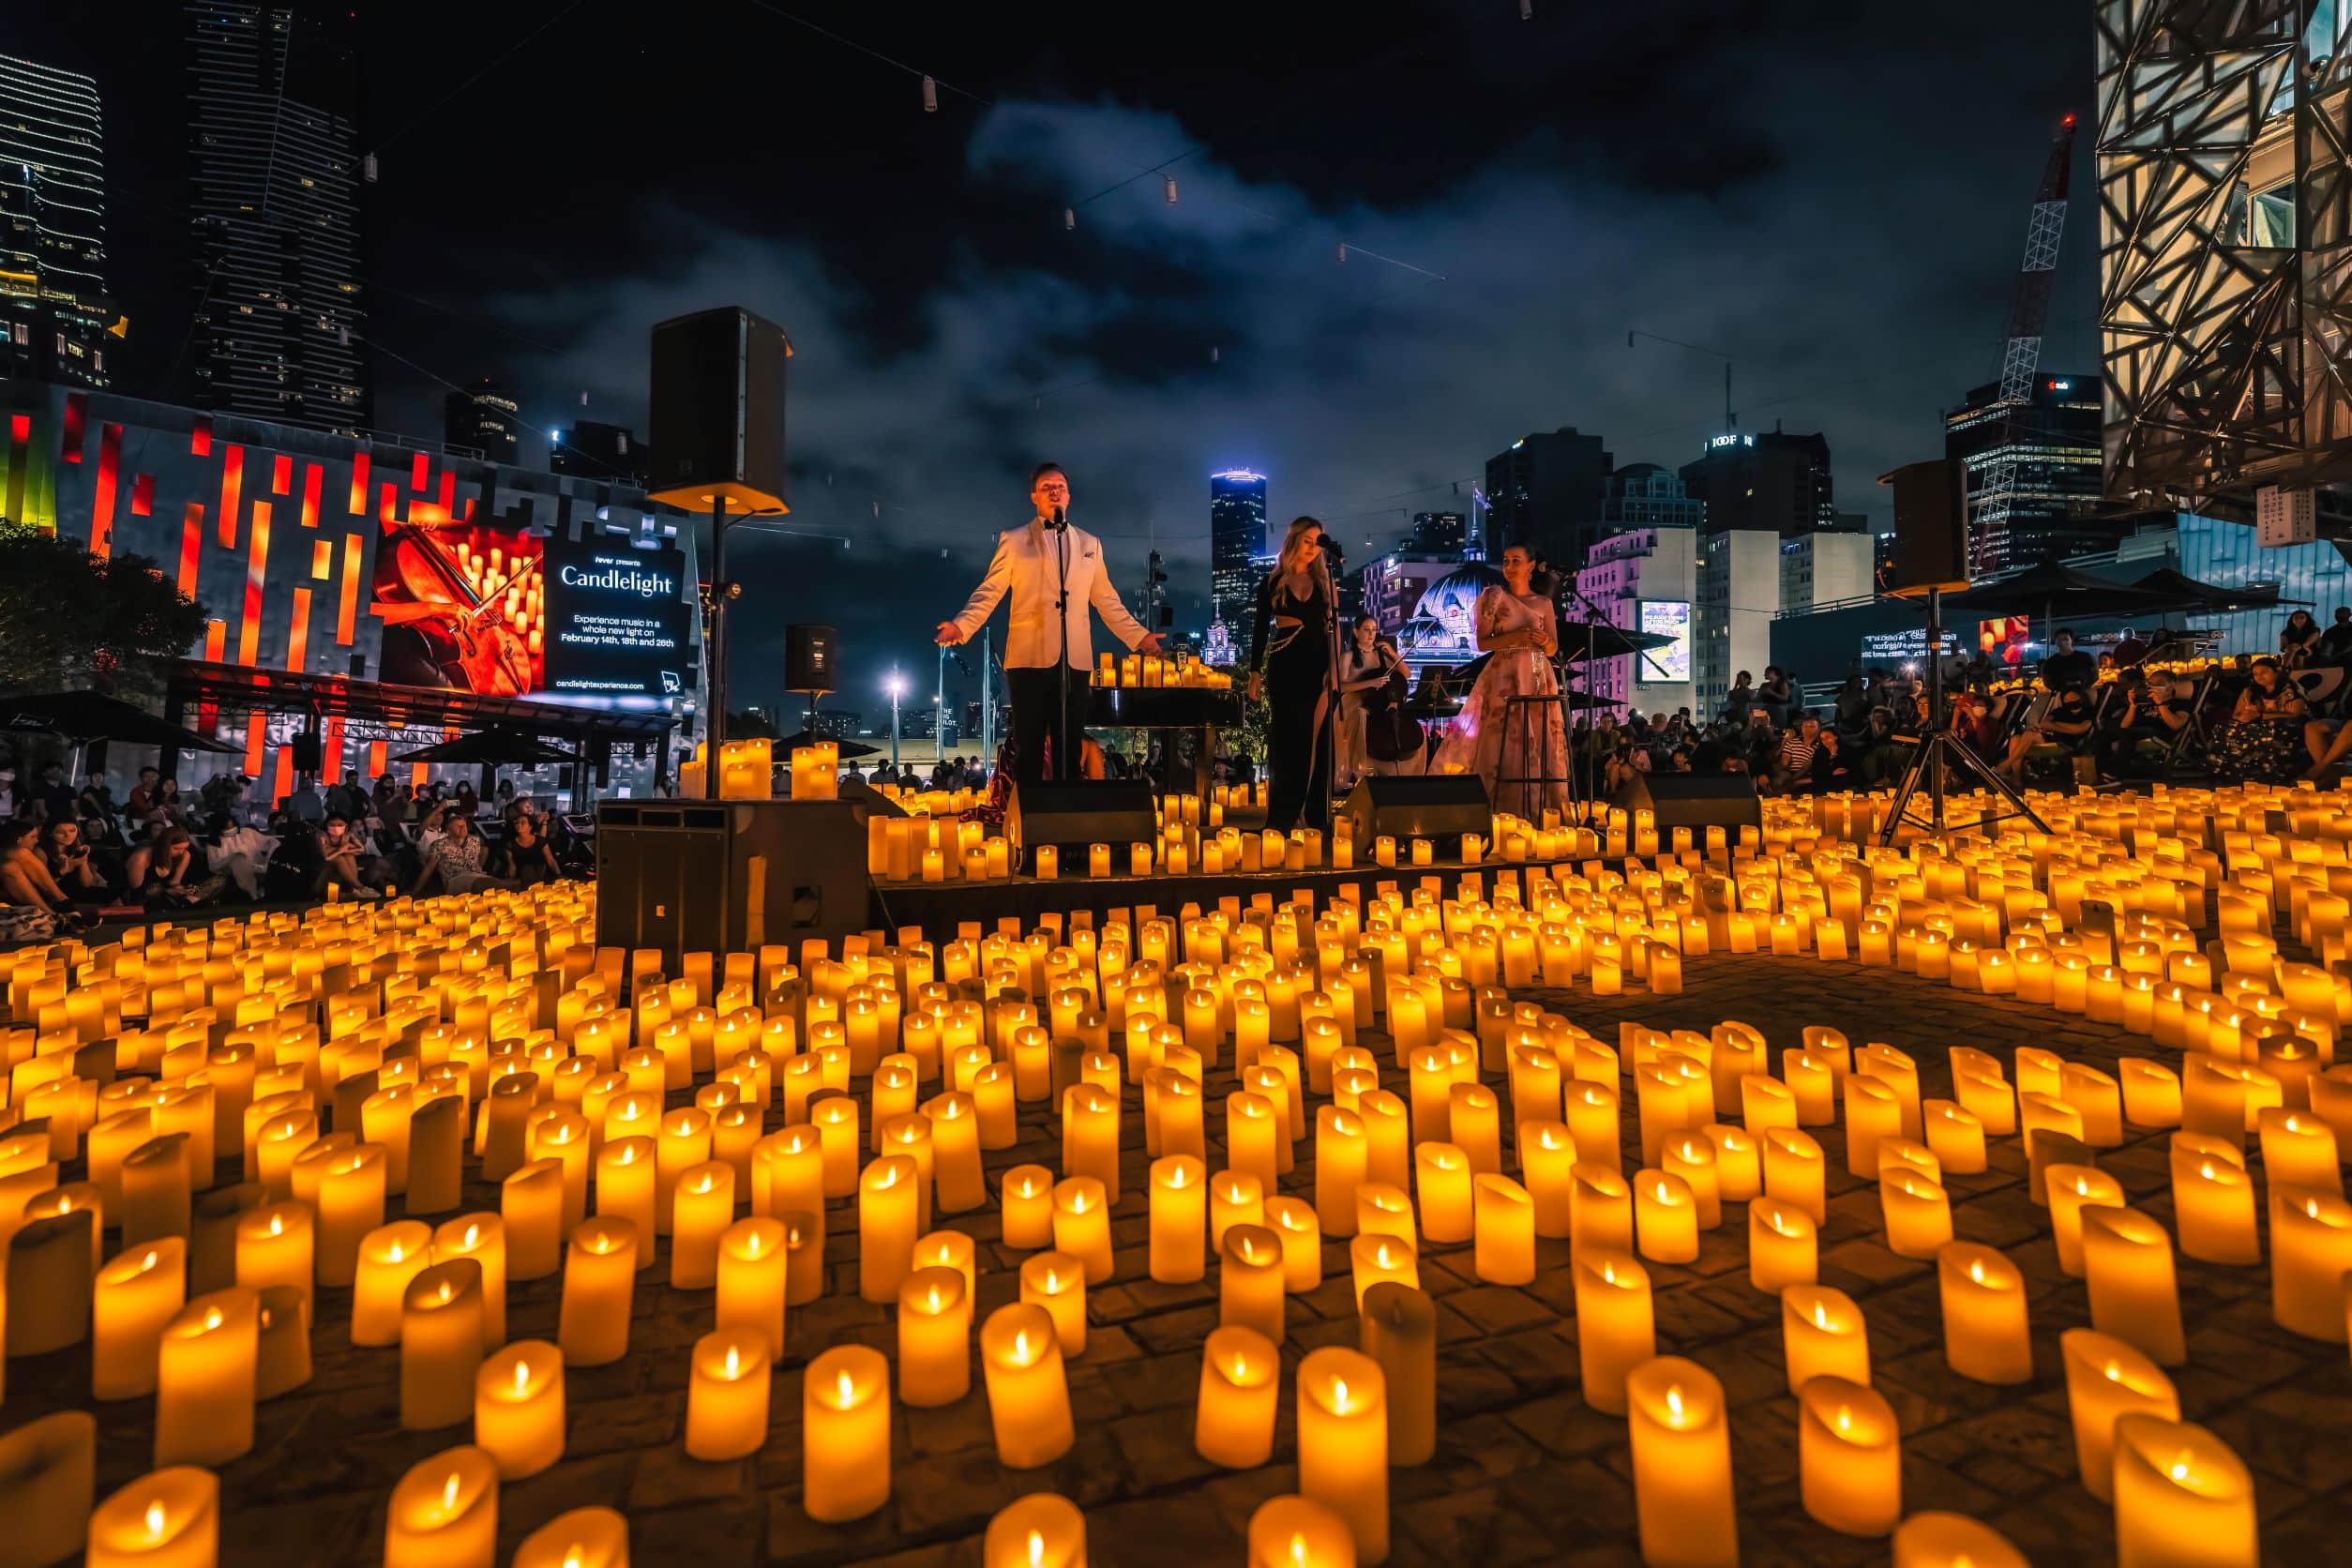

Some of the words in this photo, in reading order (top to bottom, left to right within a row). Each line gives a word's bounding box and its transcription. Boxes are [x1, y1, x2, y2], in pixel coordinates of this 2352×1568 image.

[562, 565, 672, 597] Candlelight
[574, 614, 619, 626] Experience
[621, 617, 644, 626] music
[646, 618, 653, 627] in
[655, 620, 660, 628] a
[582, 625, 607, 634] whole
[626, 627, 642, 637] light
[561, 633, 599, 644] February
[639, 638, 654, 646] and
[556, 680, 644, 690] candlelightexperience.com
